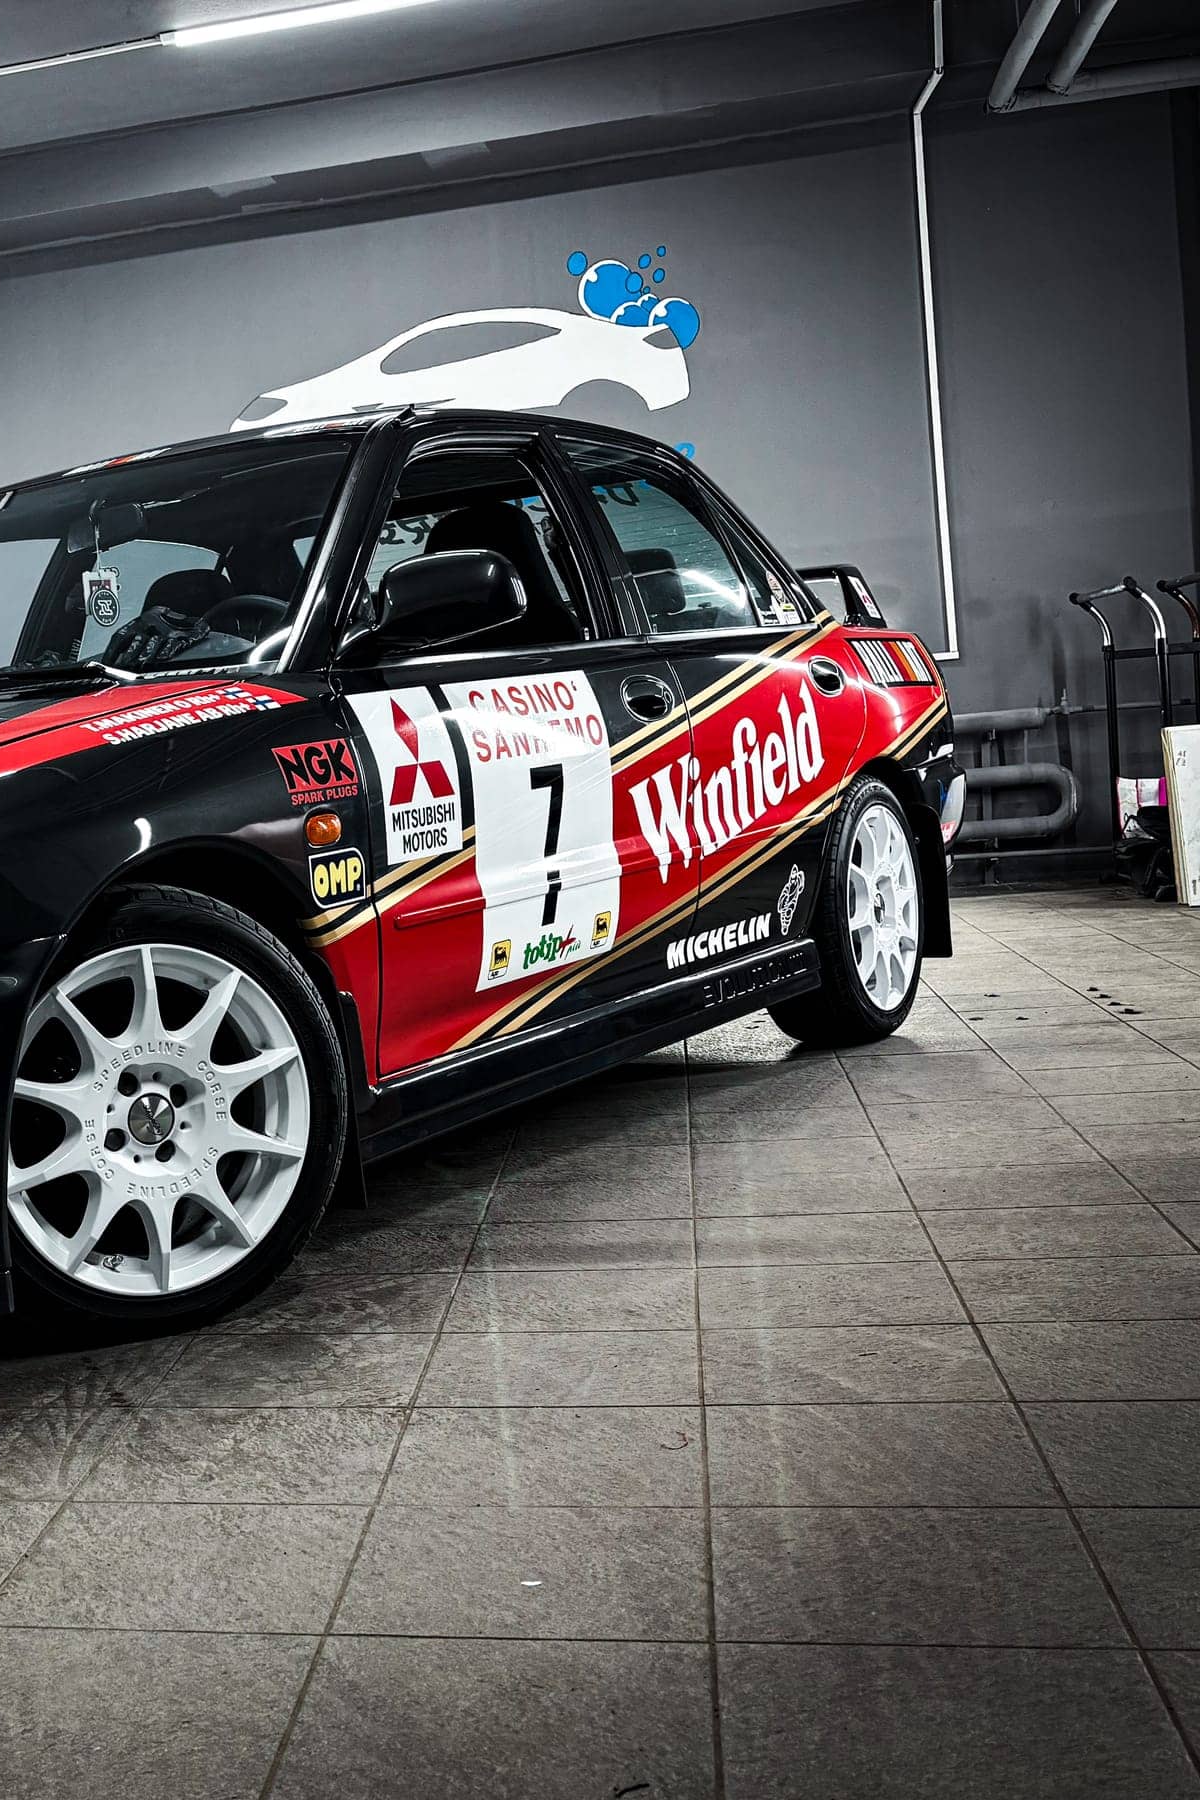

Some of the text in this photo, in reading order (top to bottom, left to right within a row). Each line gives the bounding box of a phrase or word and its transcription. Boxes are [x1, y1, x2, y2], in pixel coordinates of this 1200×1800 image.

[195, 707, 225, 722] AB
[472, 714, 603, 763] SANMO
[274, 740, 355, 790] NGK
[628, 678, 825, 884] Winfield
[291, 784, 359, 806] SPARK PLUGS
[391, 802, 456, 832] MITSUBISHI
[402, 827, 448, 854] MOTORS
[530, 763, 564, 926] 7
[313, 856, 362, 898] OMP
[666, 912, 772, 969] MICHELIN
[93, 1041, 187, 1093] SPEEDLINE
[197, 1060, 227, 1122] CORSE
[84, 1119, 115, 1180] CORSE
[127, 1146, 219, 1198] SPEEDLINE
